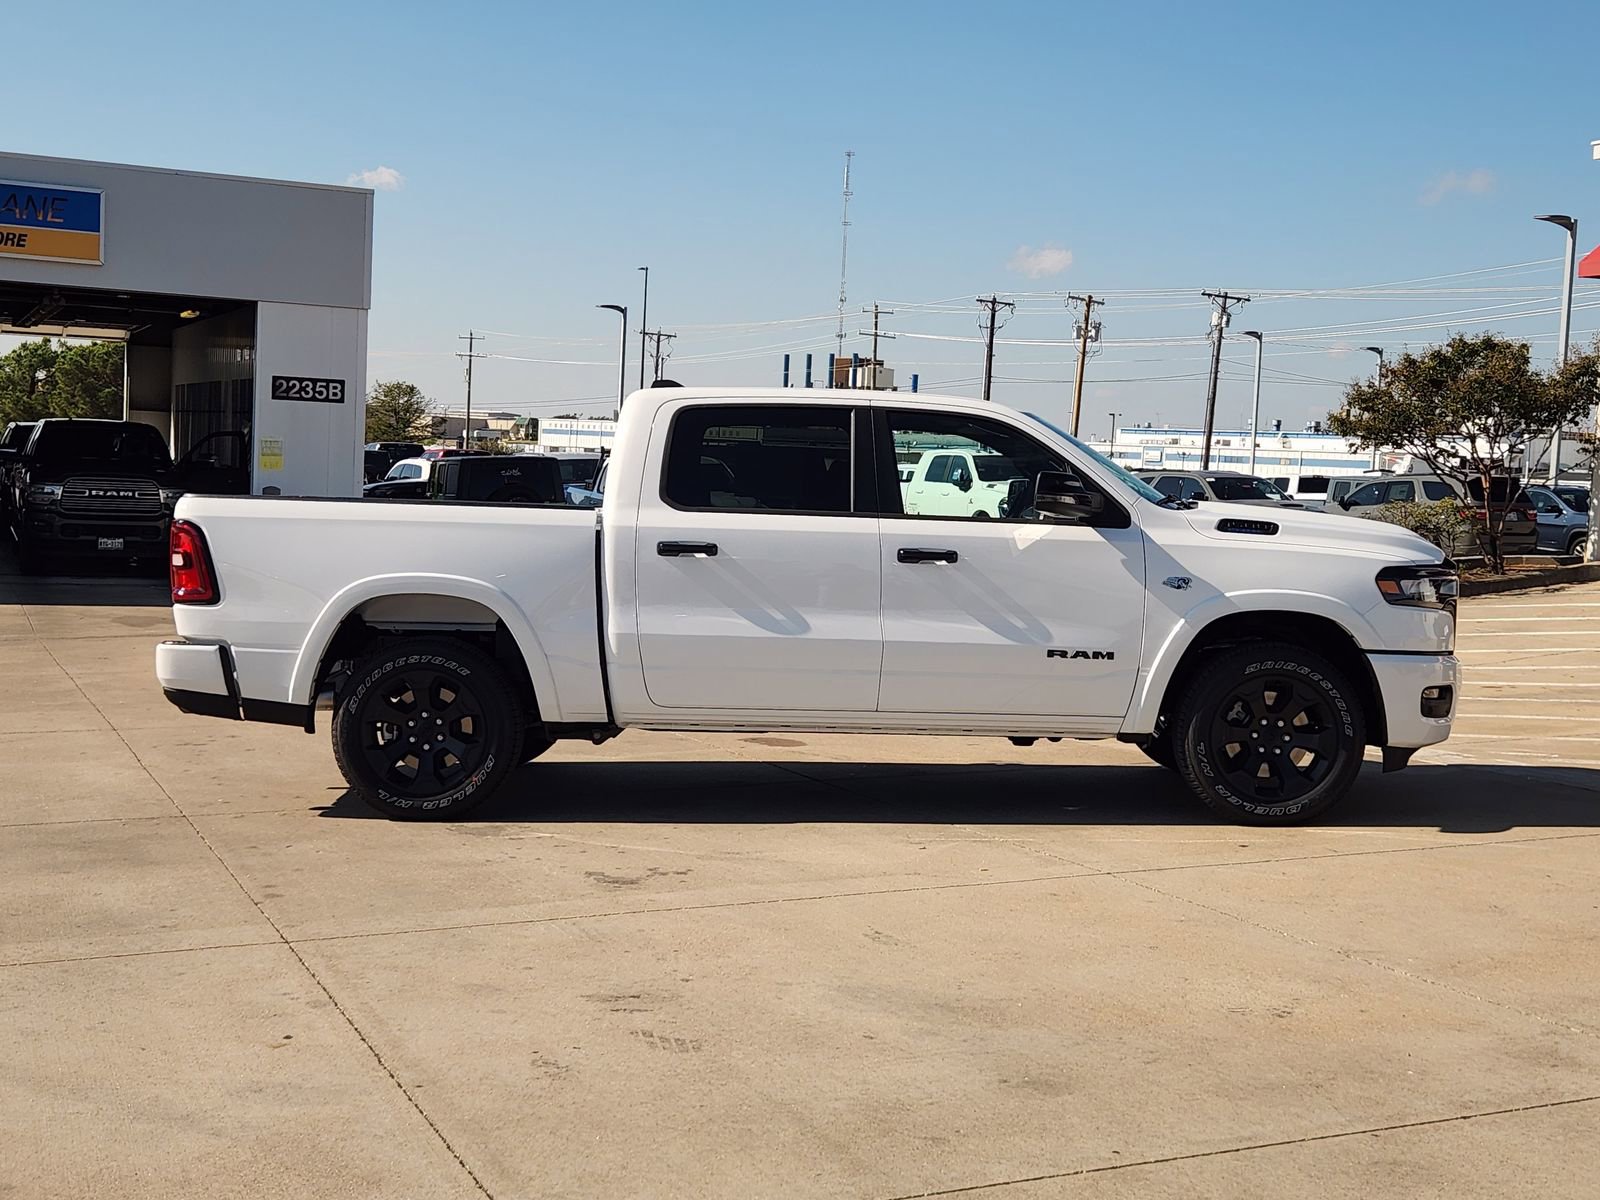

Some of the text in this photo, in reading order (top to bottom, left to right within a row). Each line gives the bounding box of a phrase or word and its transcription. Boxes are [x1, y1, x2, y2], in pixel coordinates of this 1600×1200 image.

[275, 379, 342, 400] 2235B
[1046, 649, 1115, 661] RAM
[349, 655, 473, 715] BRIDGESTONE
[1243, 660, 1354, 738] BRIDGESTONE
[422, 754, 496, 811] DUELER
[1214, 784, 1302, 817] DUELER
